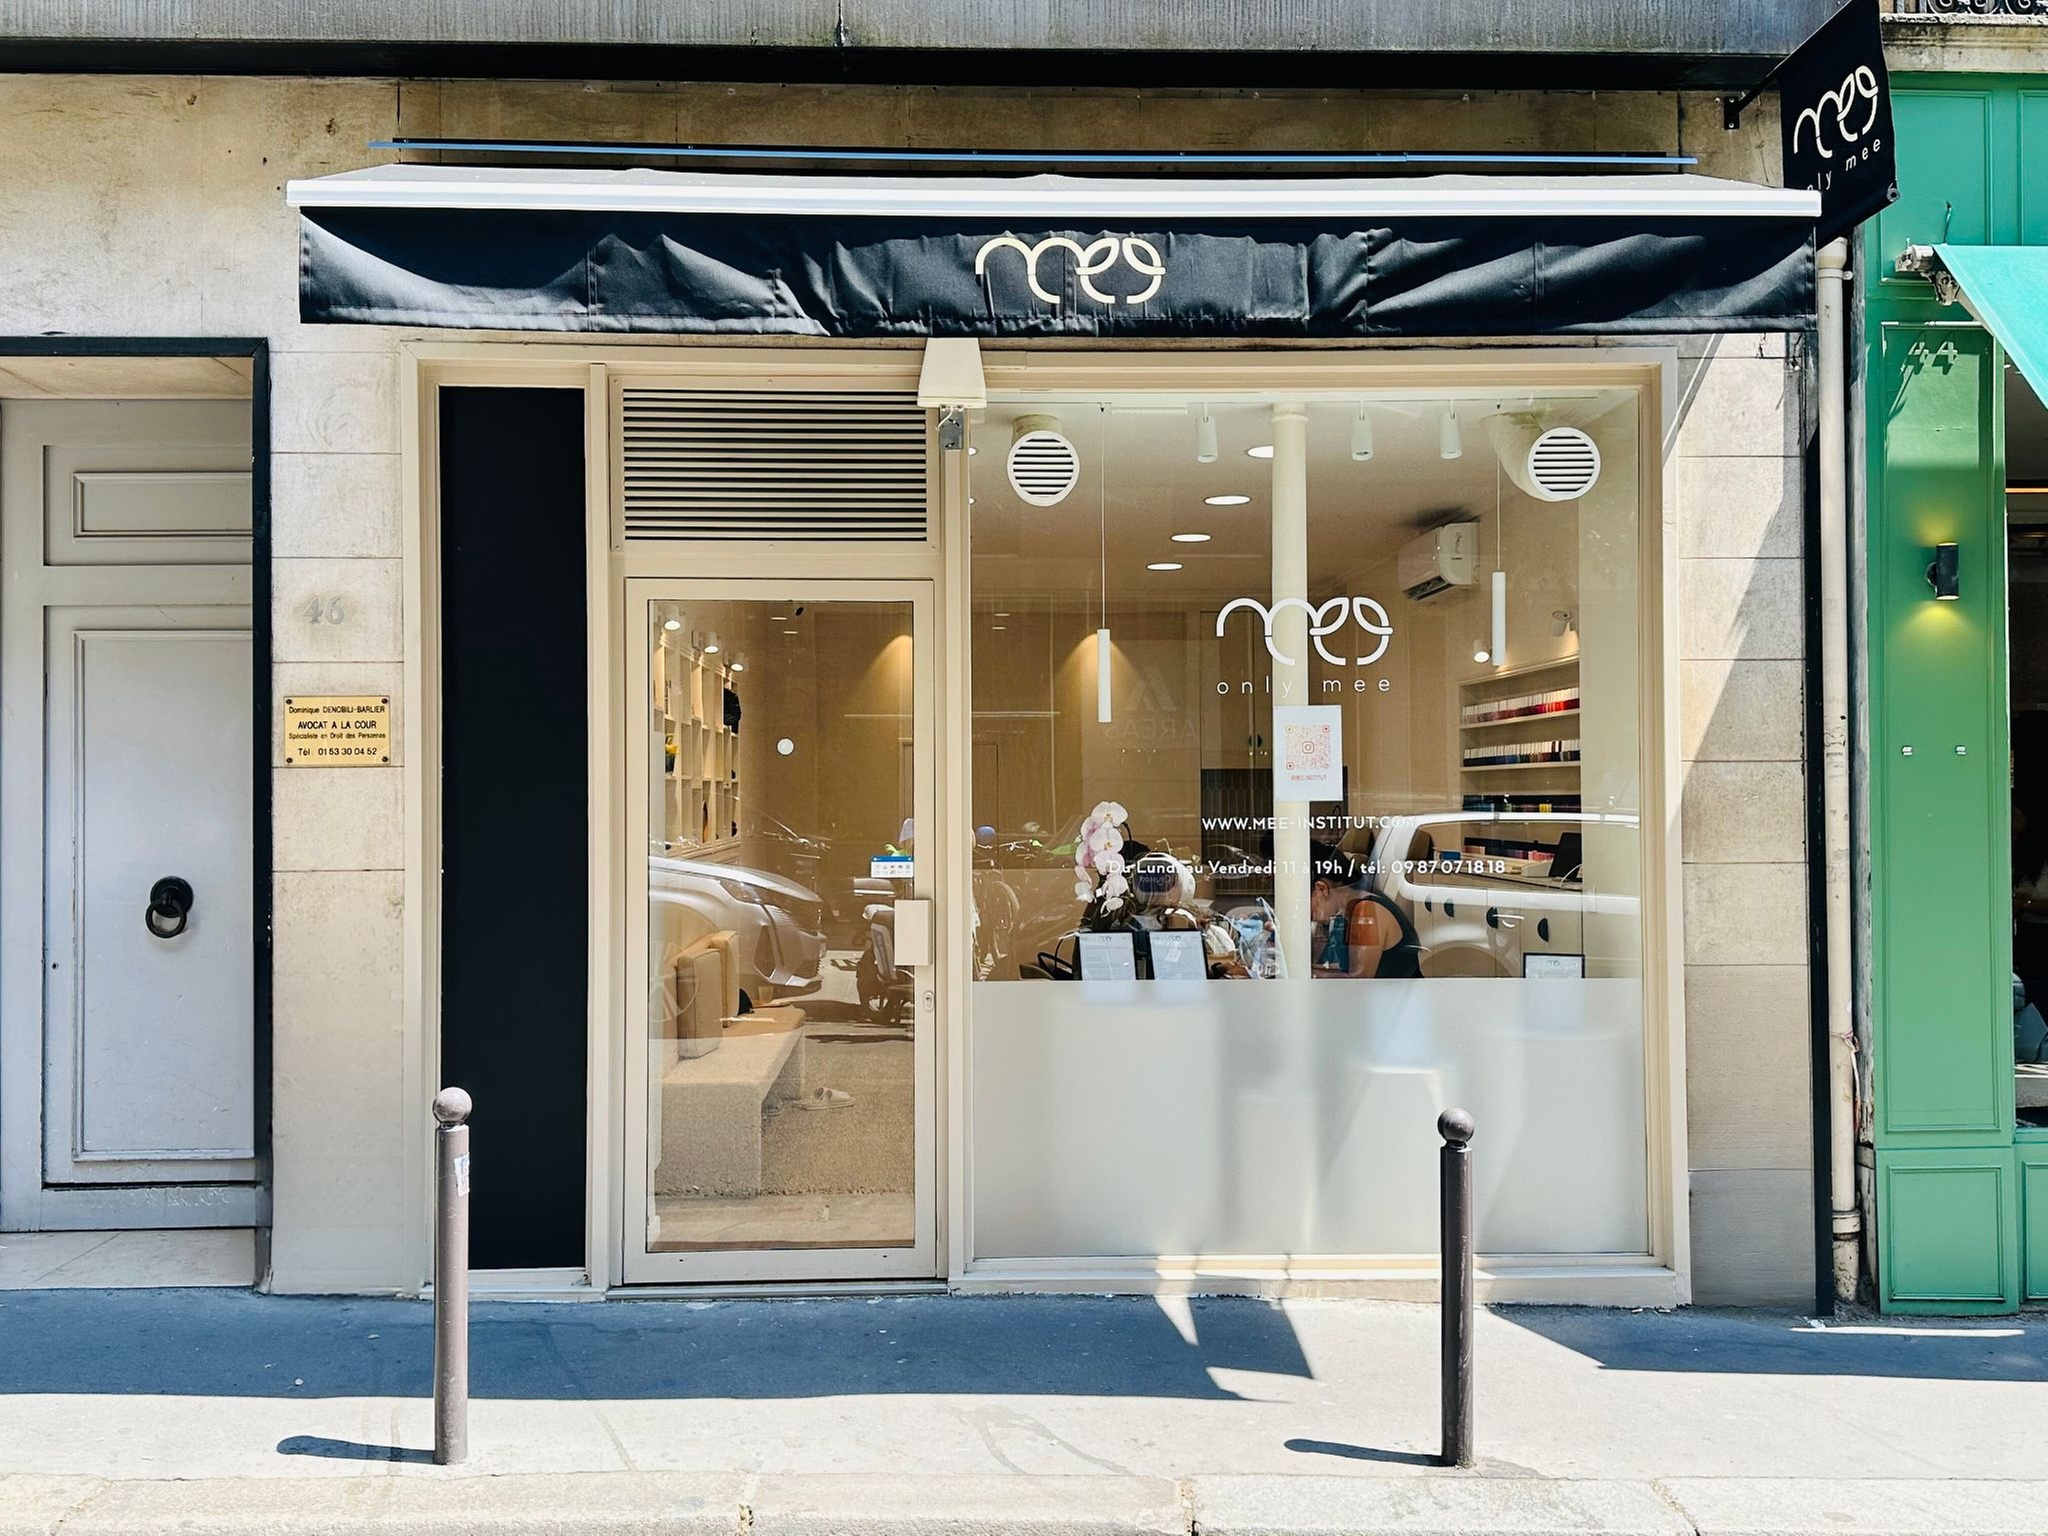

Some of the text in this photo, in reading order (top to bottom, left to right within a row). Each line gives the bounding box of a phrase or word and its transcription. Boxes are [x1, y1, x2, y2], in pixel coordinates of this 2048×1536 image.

[1845, 138, 1881, 171] mee
[303, 594, 344, 625] 46
[1216, 675, 1391, 699] only mee
[289, 706, 320, 715] Dominique
[298, 720, 377, 730] AVOCAT A LA COUR
[317, 748, 327, 756] 01
[329, 748, 340, 756] 53
[341, 748, 352, 756] 30
[354, 747, 365, 756] 04
[367, 747, 378, 756] 52
[1136, 859, 1178, 873] Lund
[1208, 859, 1277, 874] Vendredi
[1283, 861, 1296, 874] 11
[1301, 860, 1310, 874] à
[1314, 860, 1343, 874] 19h
[1347, 858, 1356, 877] /
[1360, 860, 1386, 875] tél:
